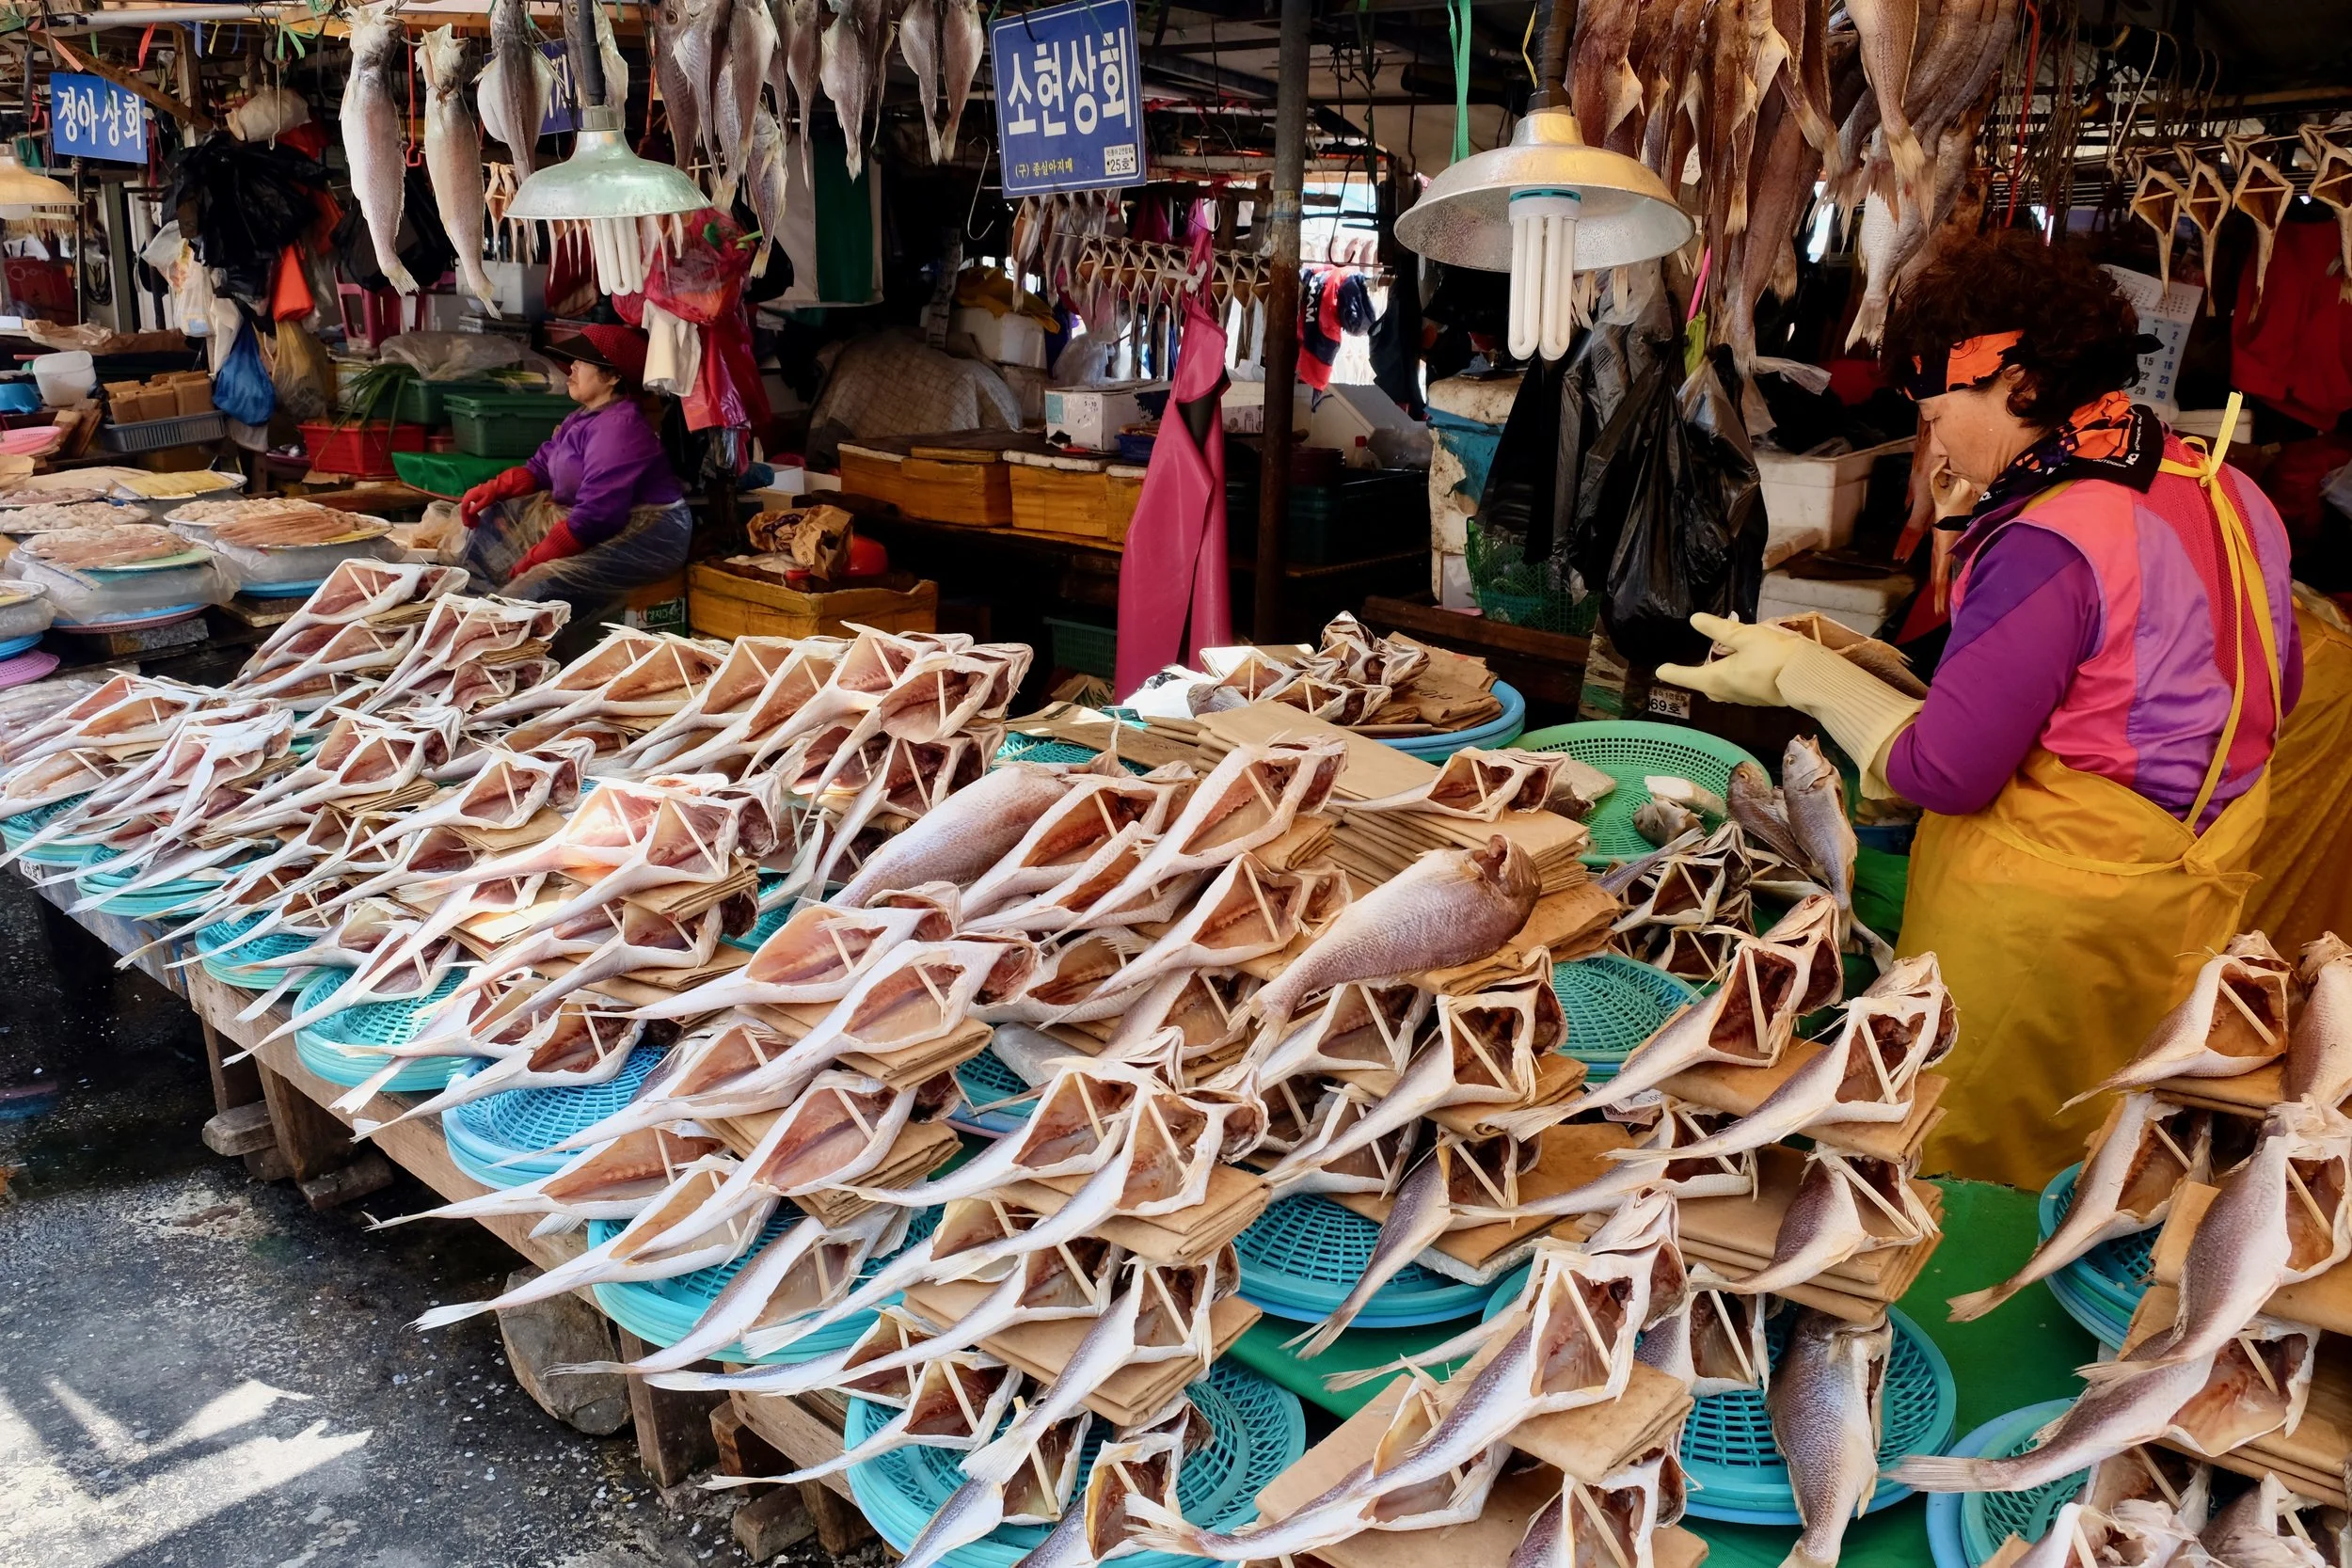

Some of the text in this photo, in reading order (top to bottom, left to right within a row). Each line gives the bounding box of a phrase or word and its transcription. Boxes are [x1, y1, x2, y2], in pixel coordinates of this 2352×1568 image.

[1008, 27, 1132, 137] 소현상회
[1110, 158, 1131, 172] 25호
[2172, 331, 2179, 340] 2
[2144, 357, 2173, 370] 15 16
[2159, 375, 2169, 385] 23
[2135, 387, 2166, 399] 29 30
[1650, 698, 1681, 715] 69호
